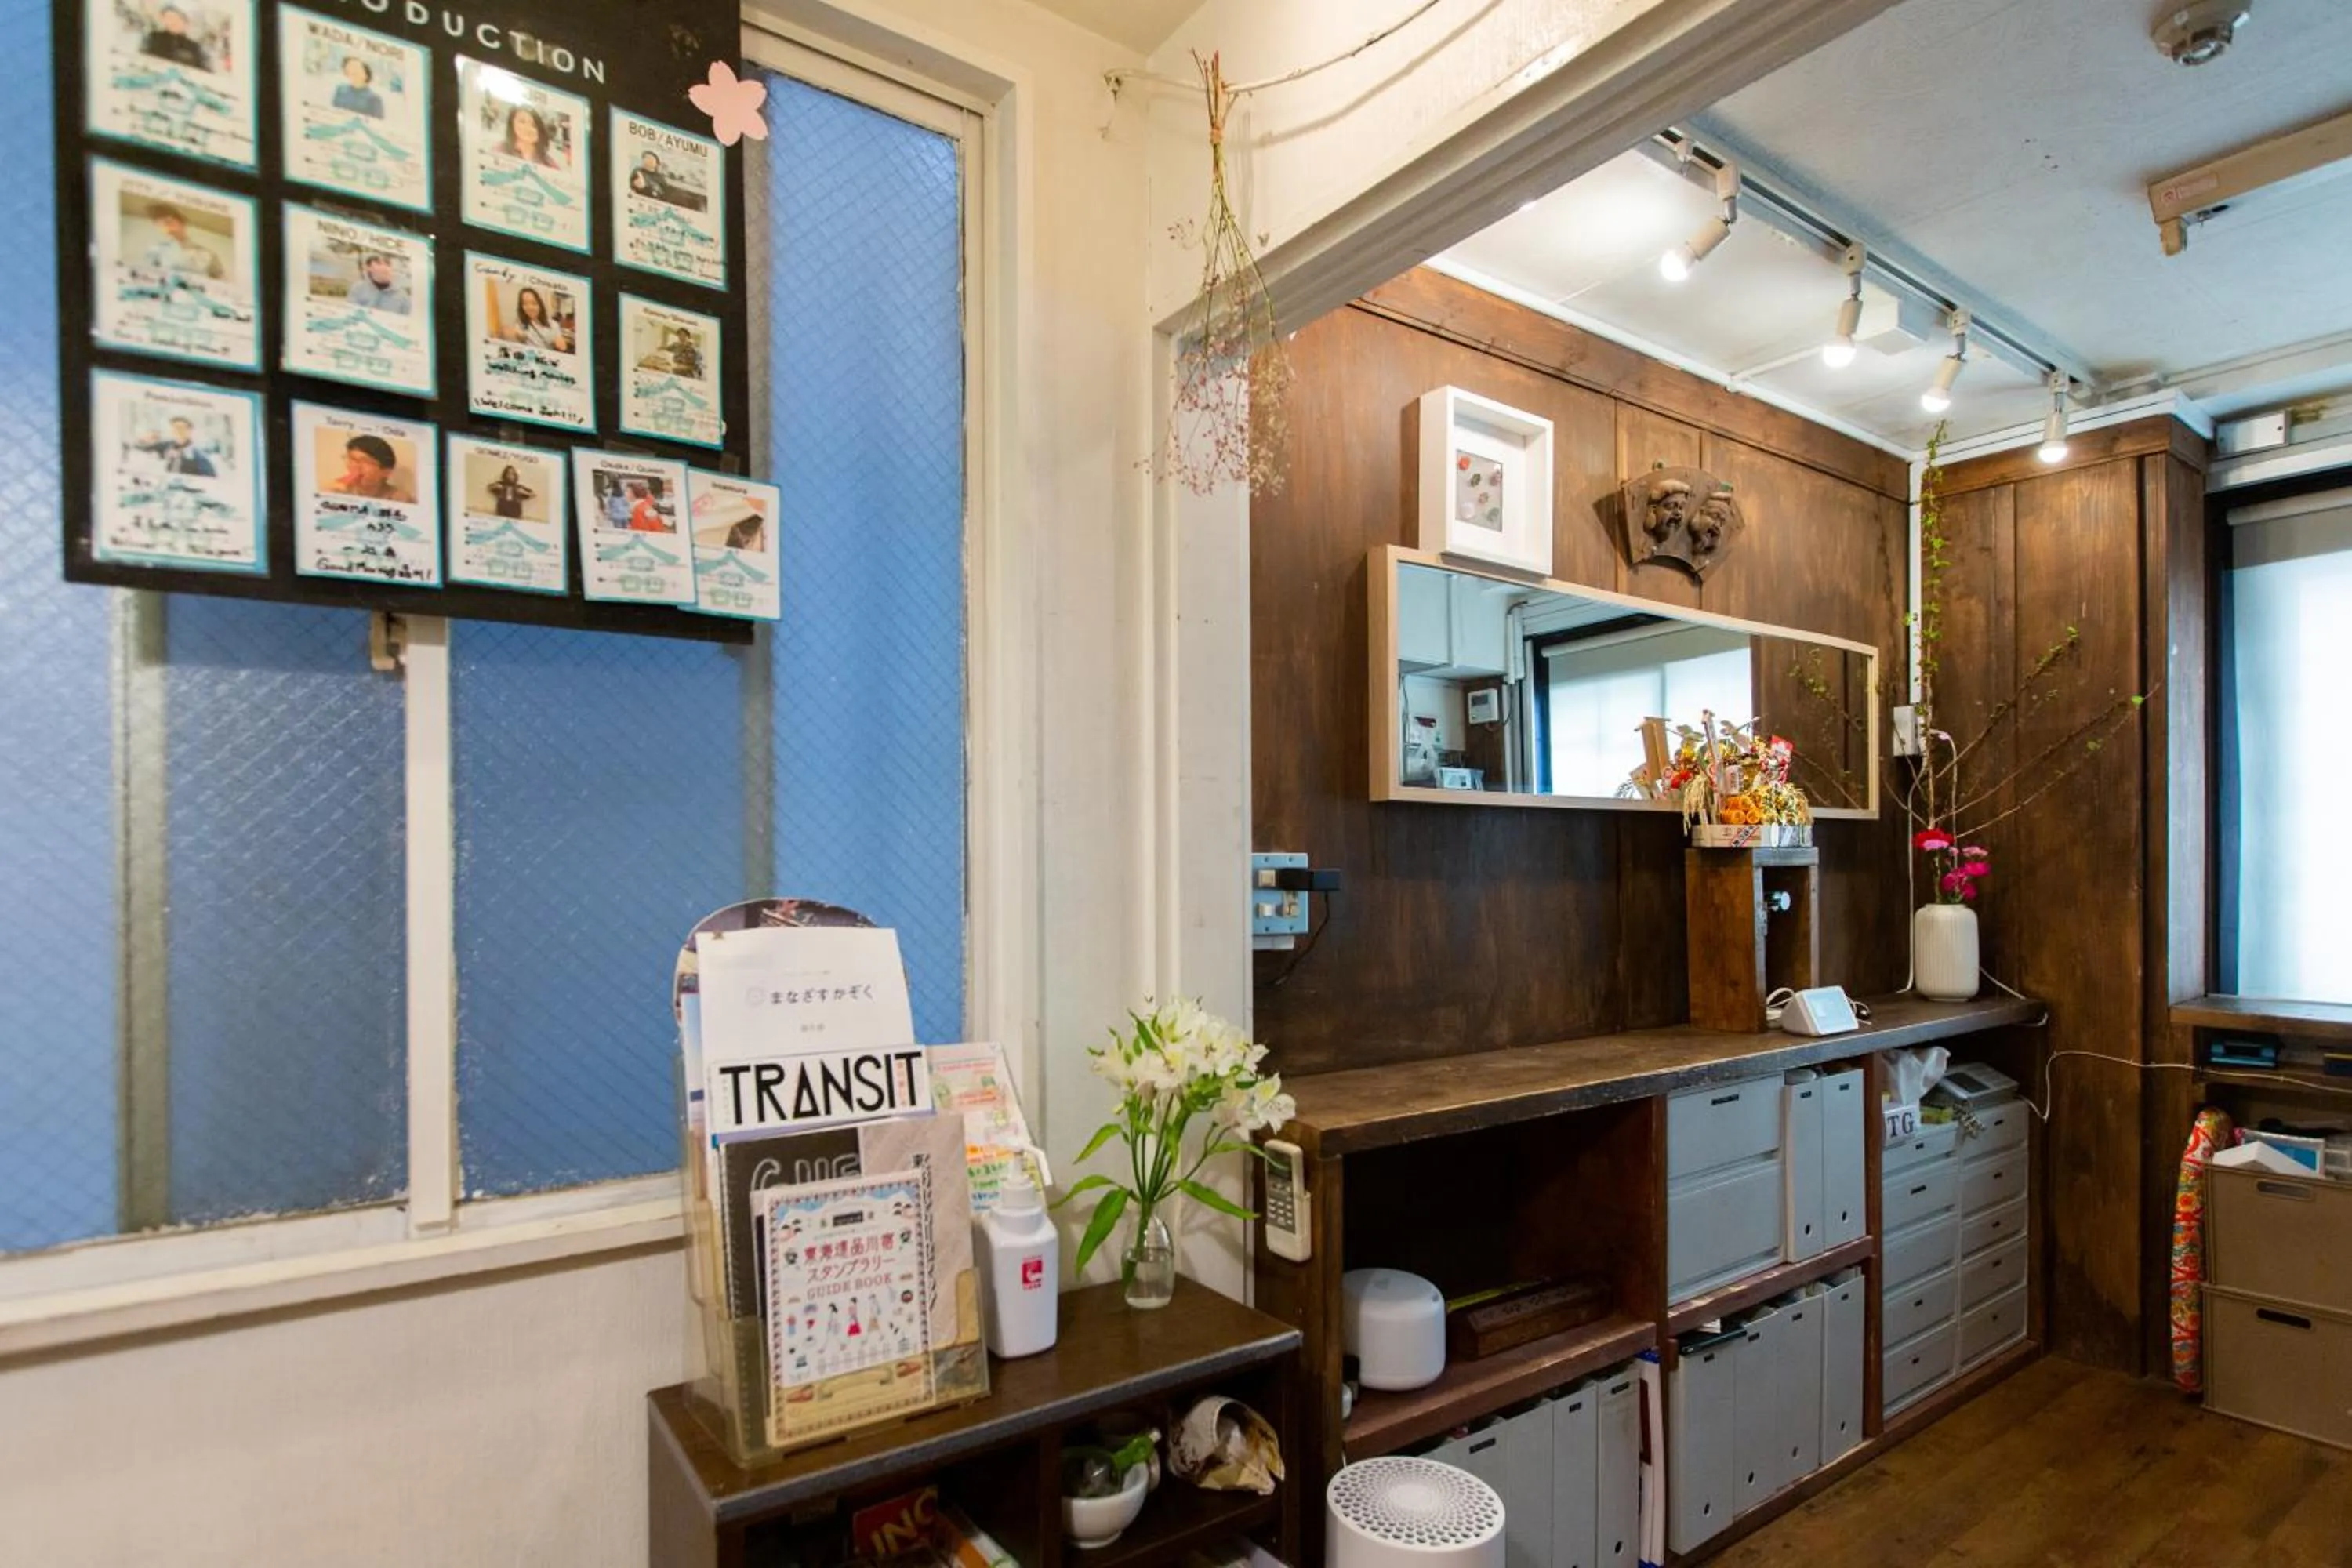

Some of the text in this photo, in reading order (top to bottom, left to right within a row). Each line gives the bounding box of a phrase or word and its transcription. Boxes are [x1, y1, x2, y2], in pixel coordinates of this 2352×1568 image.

[340, 0, 605, 85] ODUCTION
[628, 121, 656, 141] BOB
[720, 1051, 922, 1125] TRANSIT
[807, 1255, 896, 1283] スタンプラリー
[807, 1273, 892, 1301] GUIDE BOOK
